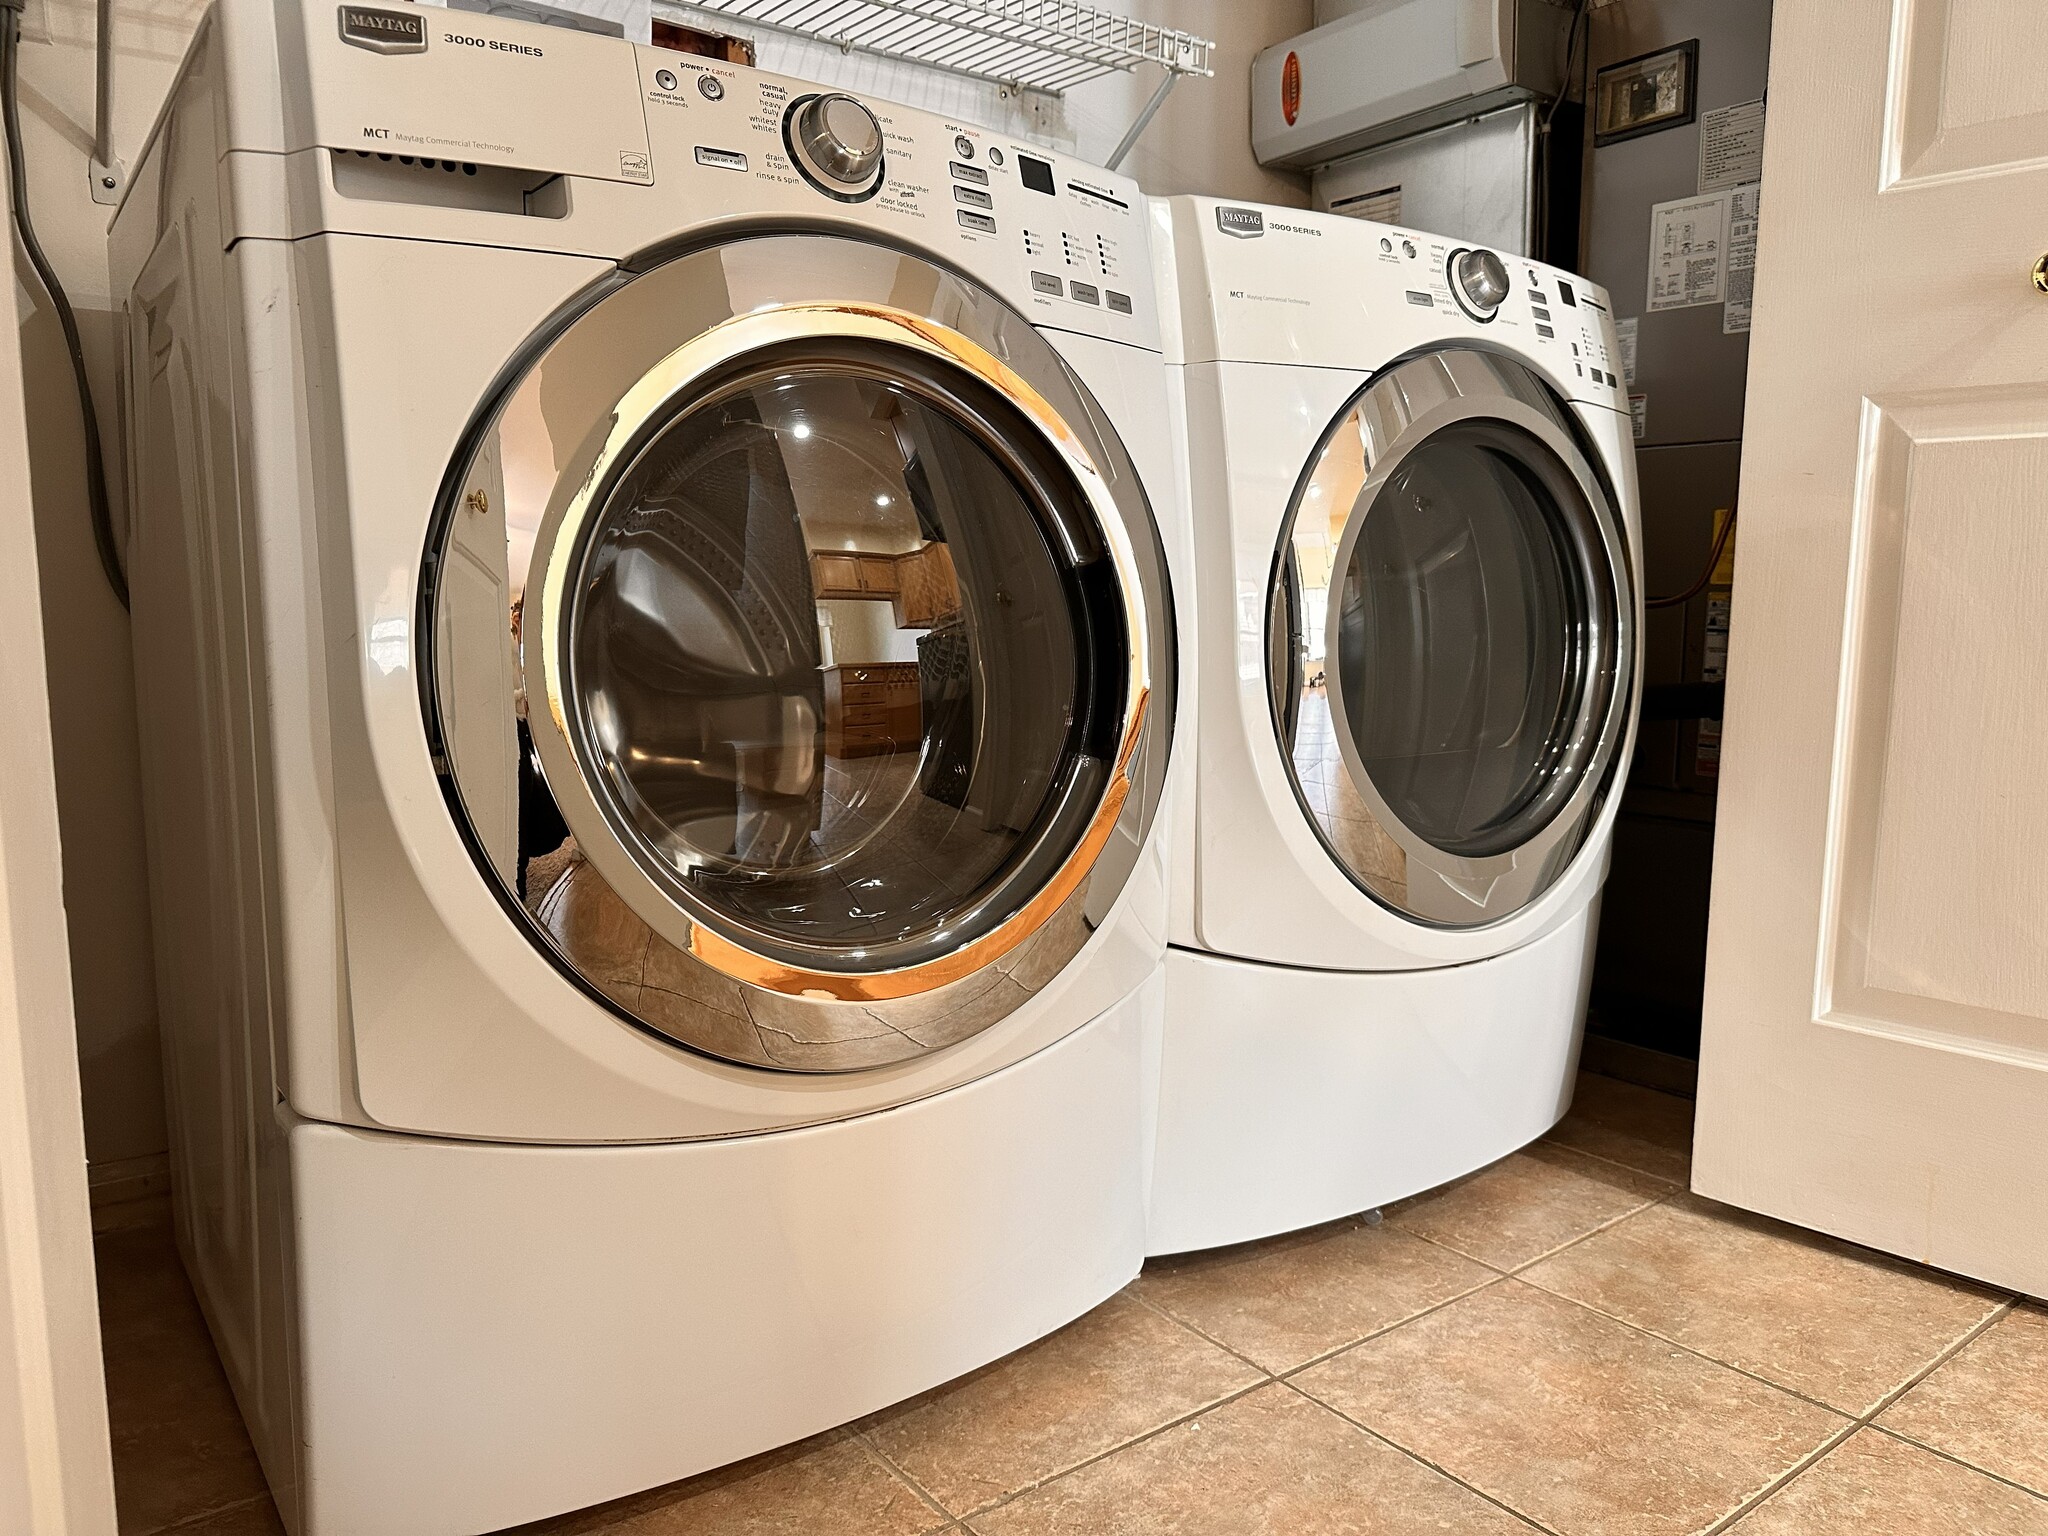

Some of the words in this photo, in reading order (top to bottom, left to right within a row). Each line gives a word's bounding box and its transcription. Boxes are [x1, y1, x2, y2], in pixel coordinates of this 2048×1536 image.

[350, 14, 416, 34] MAYTAG
[444, 34, 485, 47] 3000
[489, 40, 543, 57] SERIES
[680, 62, 703, 71] power
[711, 68, 736, 78] cancel
[650, 91, 671, 99] control
[762, 90, 786, 101] casual
[759, 98, 781, 110] heavy
[763, 107, 778, 117] duty
[749, 116, 776, 126] whitest
[752, 124, 776, 133] whites
[945, 124, 958, 132] start
[964, 129, 980, 138] pause
[364, 128, 389, 139] MCT
[396, 133, 424, 143] Maytag
[426, 137, 471, 147] Commercial
[473, 141, 514, 153] Technology
[897, 135, 914, 144] wash
[702, 154, 720, 162] signal
[766, 153, 784, 162] drain
[886, 148, 912, 159] sanitary
[773, 162, 789, 170] spin
[757, 172, 775, 180] rinse
[888, 180, 905, 188] clean
[907, 184, 929, 193] washer
[880, 196, 896, 204] door
[897, 200, 918, 210] locked
[1224, 213, 1260, 224] MAYTAG
[1269, 223, 1291, 231] 3000
[1293, 226, 1321, 236] SERIES
